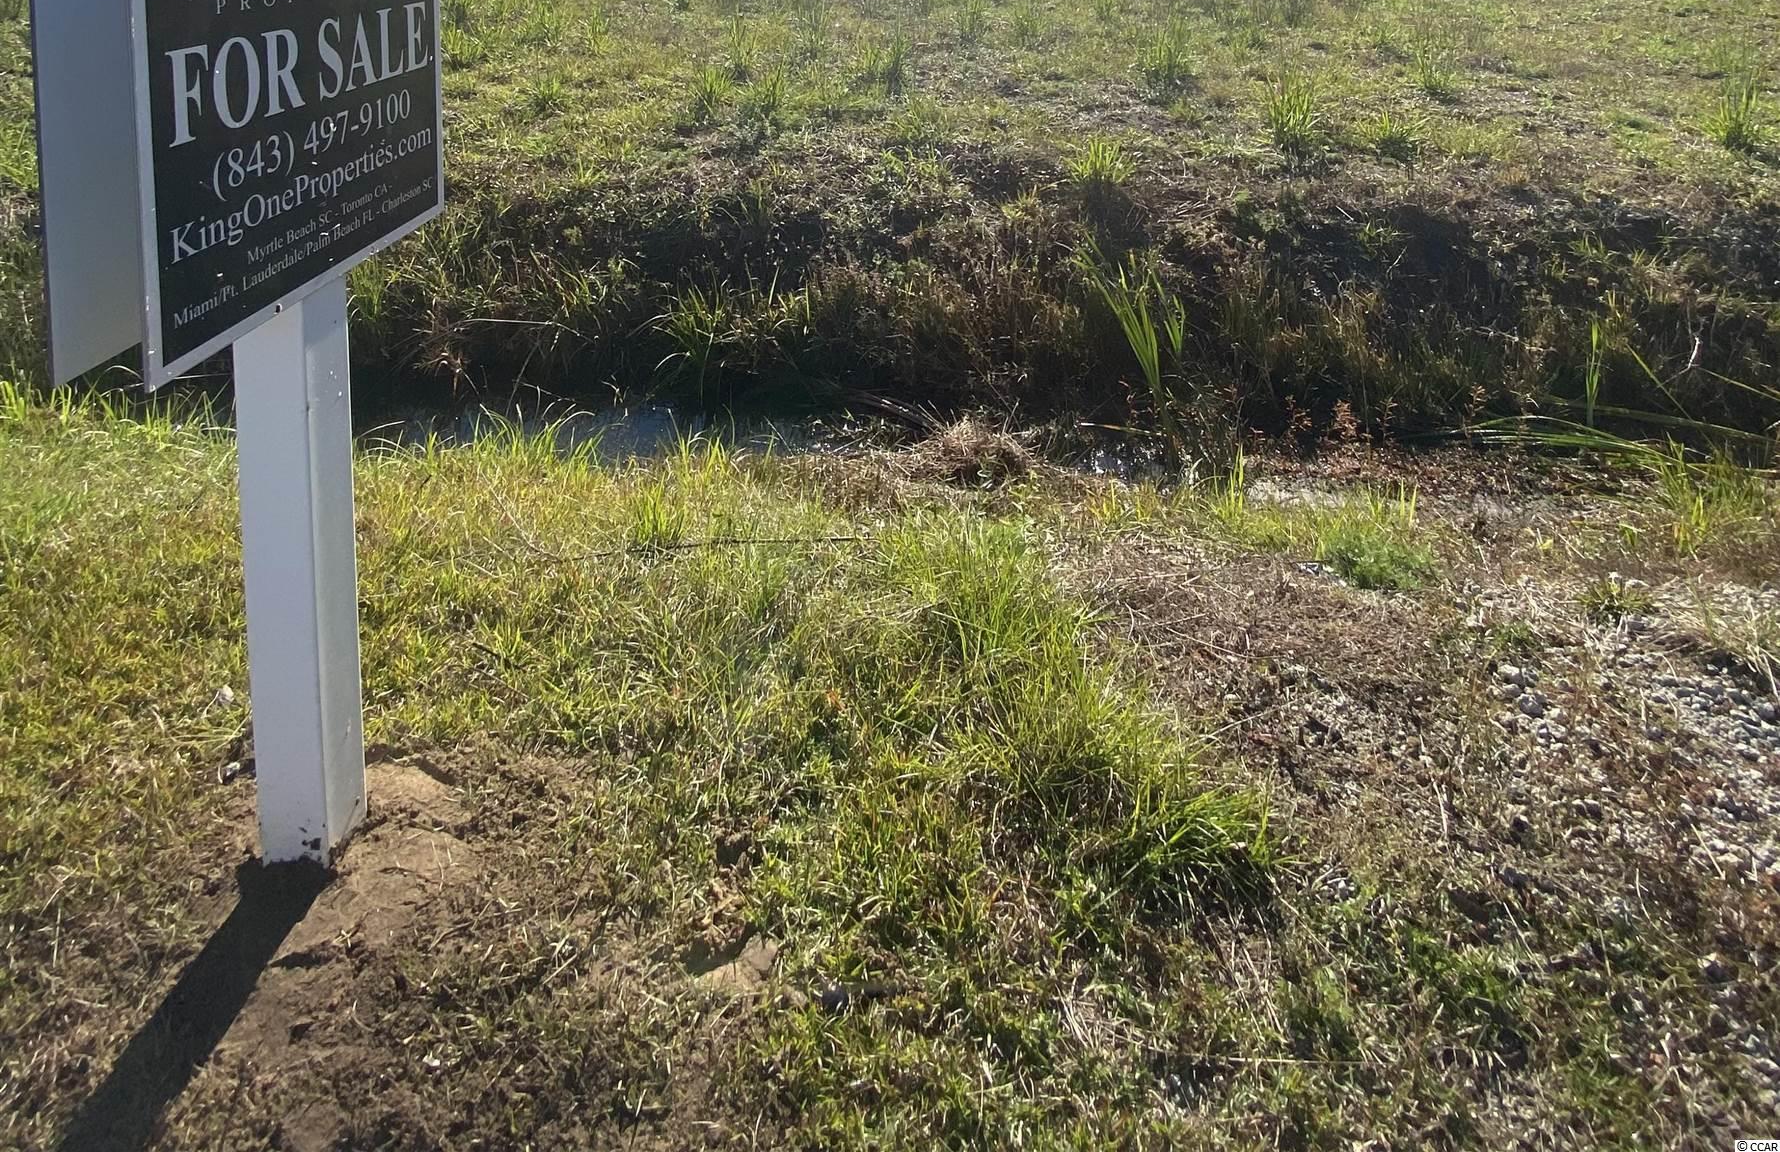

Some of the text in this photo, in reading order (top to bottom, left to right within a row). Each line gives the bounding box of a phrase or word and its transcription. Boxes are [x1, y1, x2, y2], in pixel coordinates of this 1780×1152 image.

[165, 1, 429, 148] FOR SALE
[170, 127, 432, 264] KingOneProperties.com
[213, 89, 411, 201] (843) 497-9100
[242, 234, 331, 291] Lauderdale/Palm
[333, 216, 361, 241] Beach
[362, 208, 375, 225] FL
[381, 185, 421, 214] Charleston
[422, 176, 433, 192] SC
[247, 237, 284, 265] Myrtle
[286, 218, 317, 245] Beach
[319, 209, 333, 227] SC
[341, 192, 373, 215] Toronto
[374, 183, 388, 198] CA
